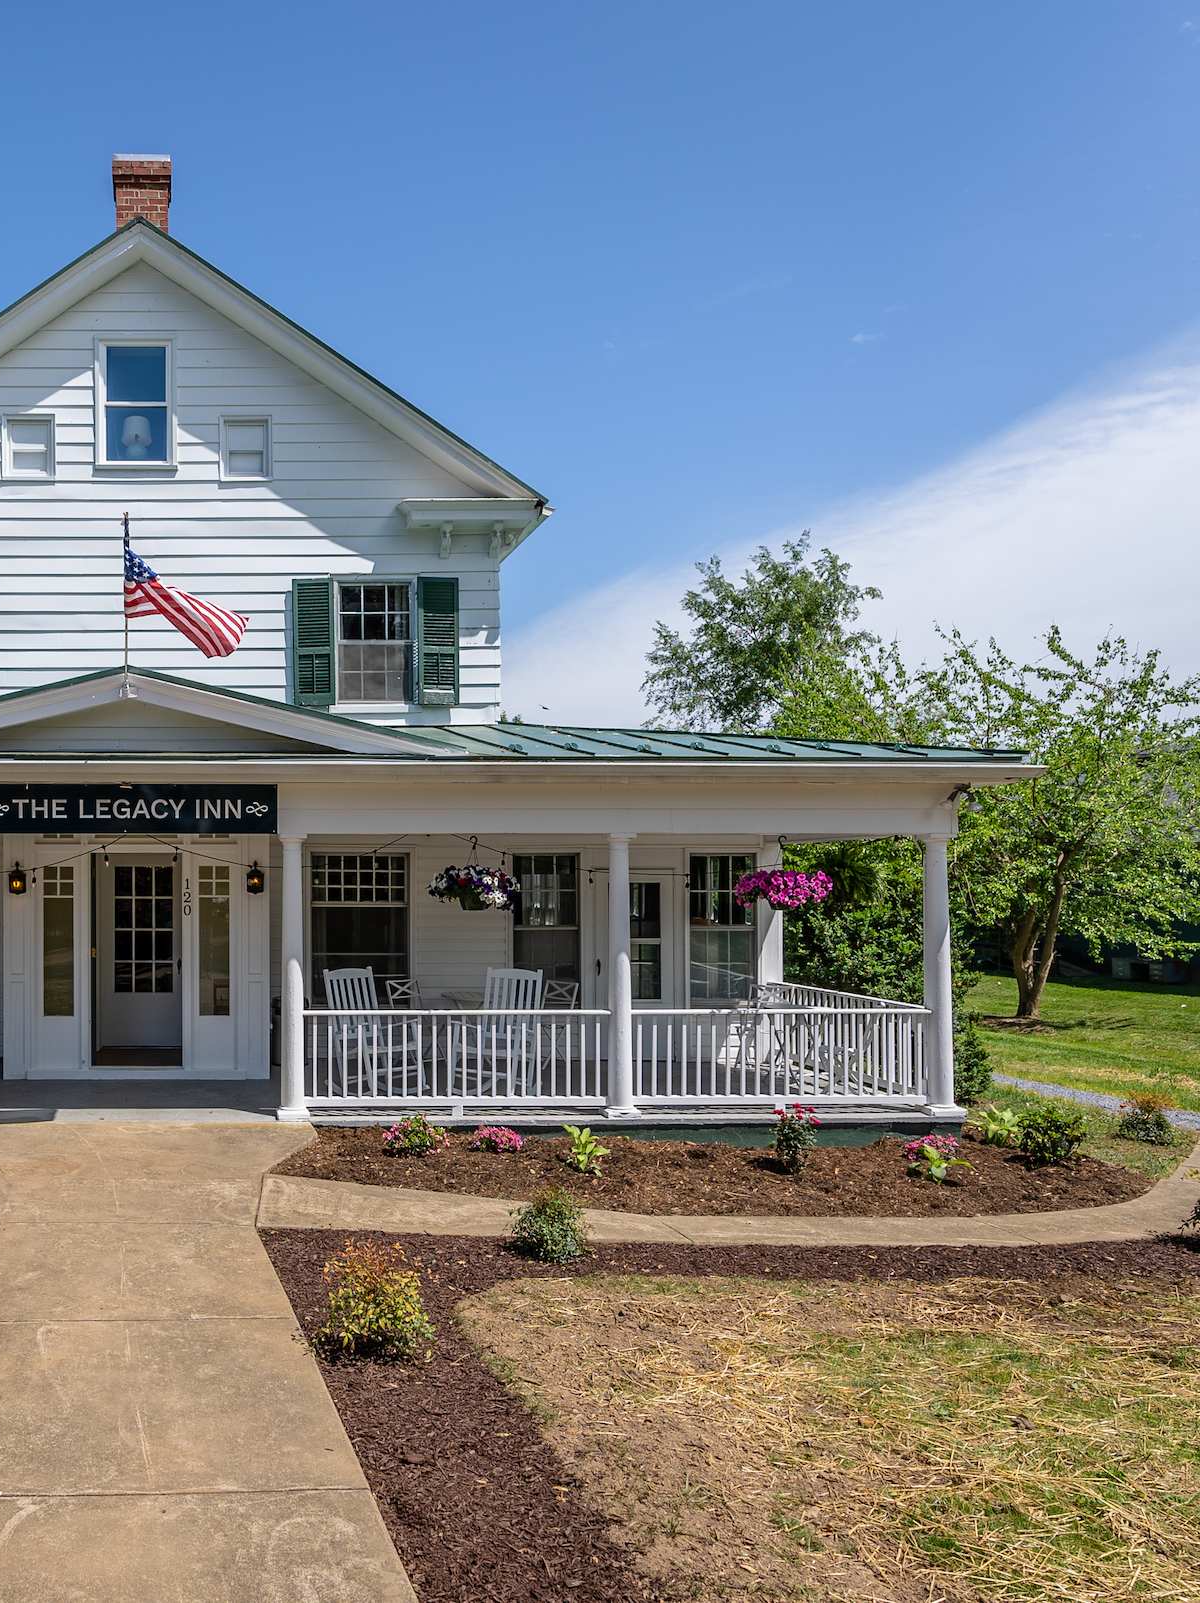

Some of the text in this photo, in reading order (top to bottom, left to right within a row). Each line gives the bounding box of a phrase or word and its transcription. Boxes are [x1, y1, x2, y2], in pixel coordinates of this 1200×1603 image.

[11, 798, 242, 819] THE LEGACY INN
[183, 878, 192, 917] 120
